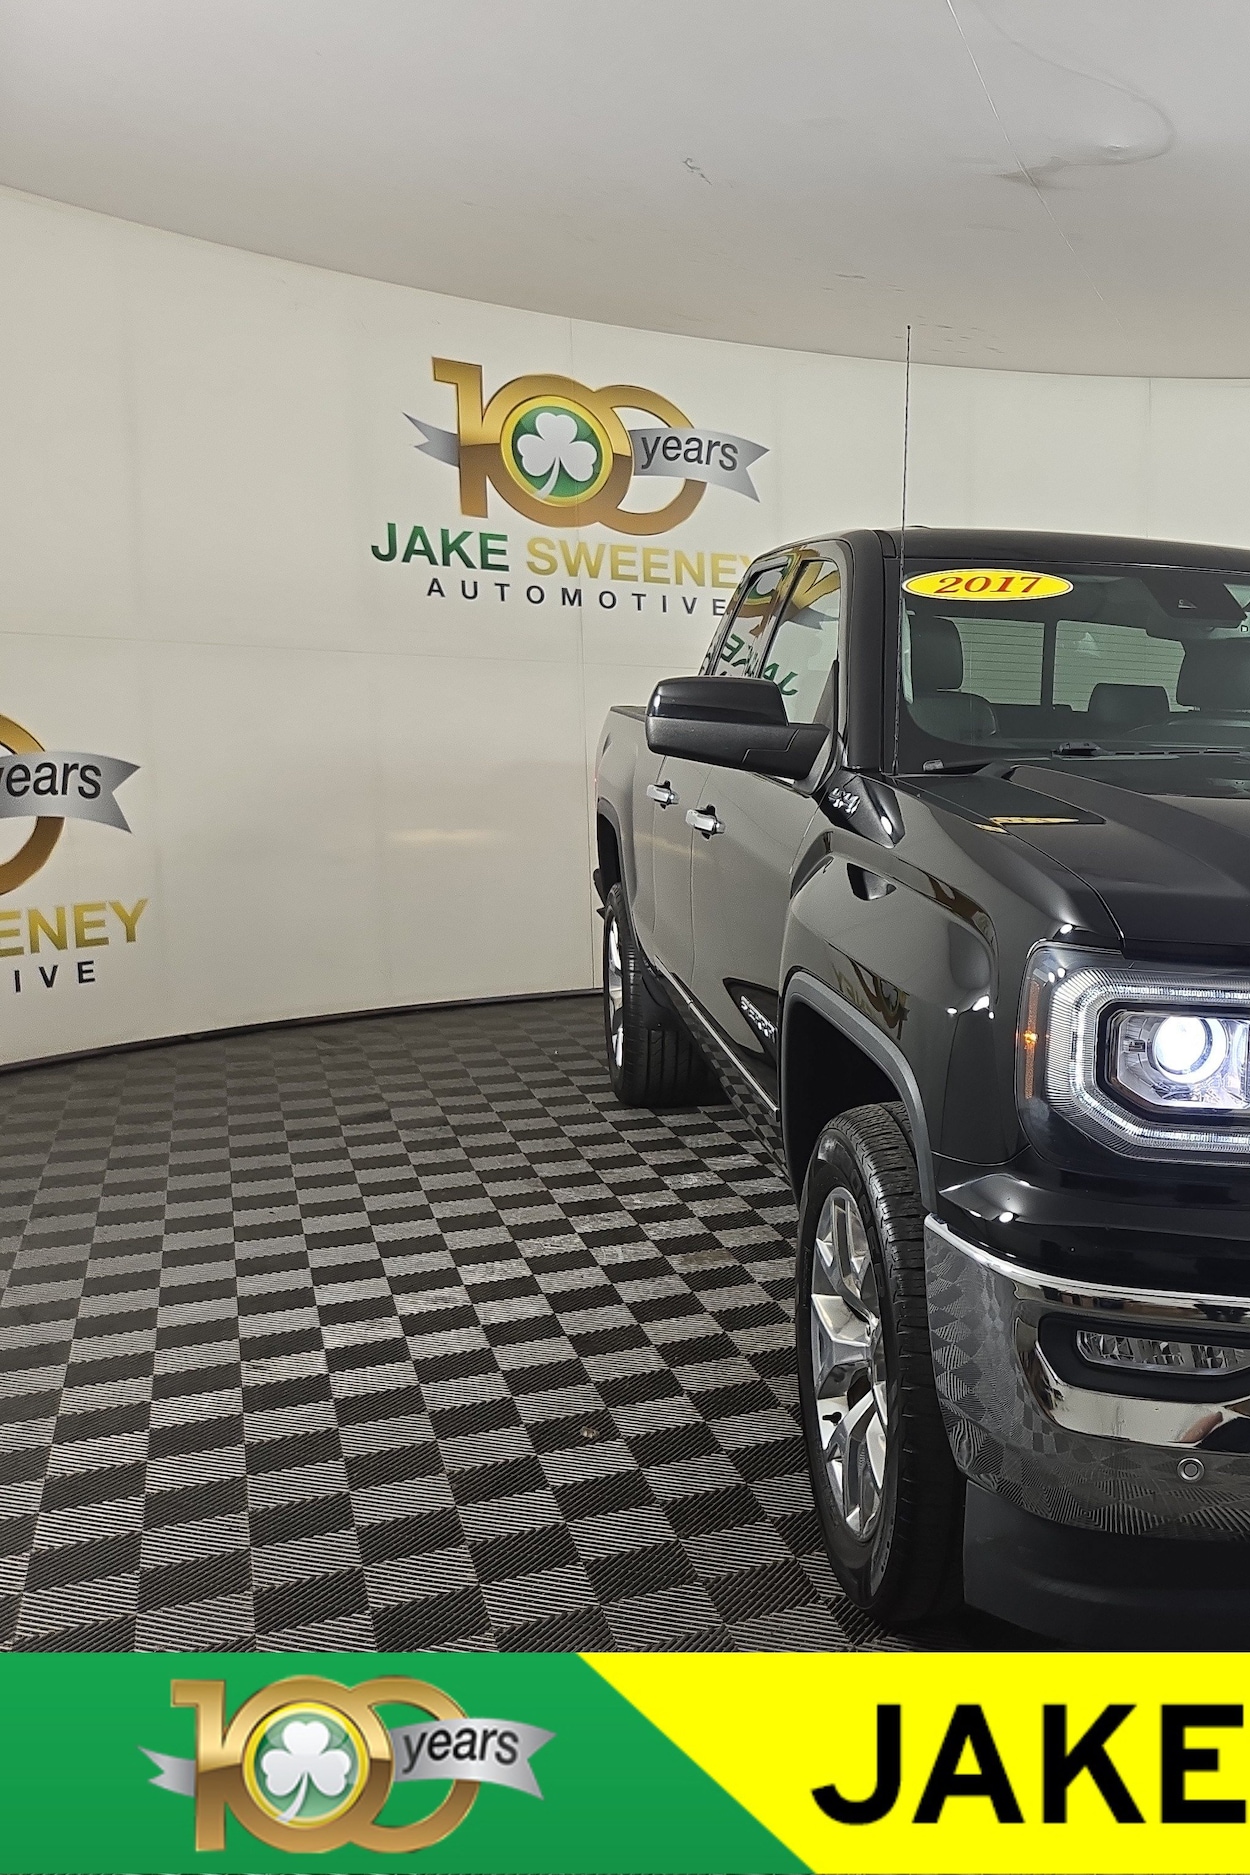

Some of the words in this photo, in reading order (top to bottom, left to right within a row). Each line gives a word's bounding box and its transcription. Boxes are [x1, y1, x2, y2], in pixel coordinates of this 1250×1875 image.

[641, 432, 739, 471] years
[371, 522, 509, 572] JAKE
[427, 577, 726, 616] AUTOMOTIVE
[934, 576, 1042, 593] 2017
[0, 761, 102, 799] ears
[0, 899, 148, 958] ENEY
